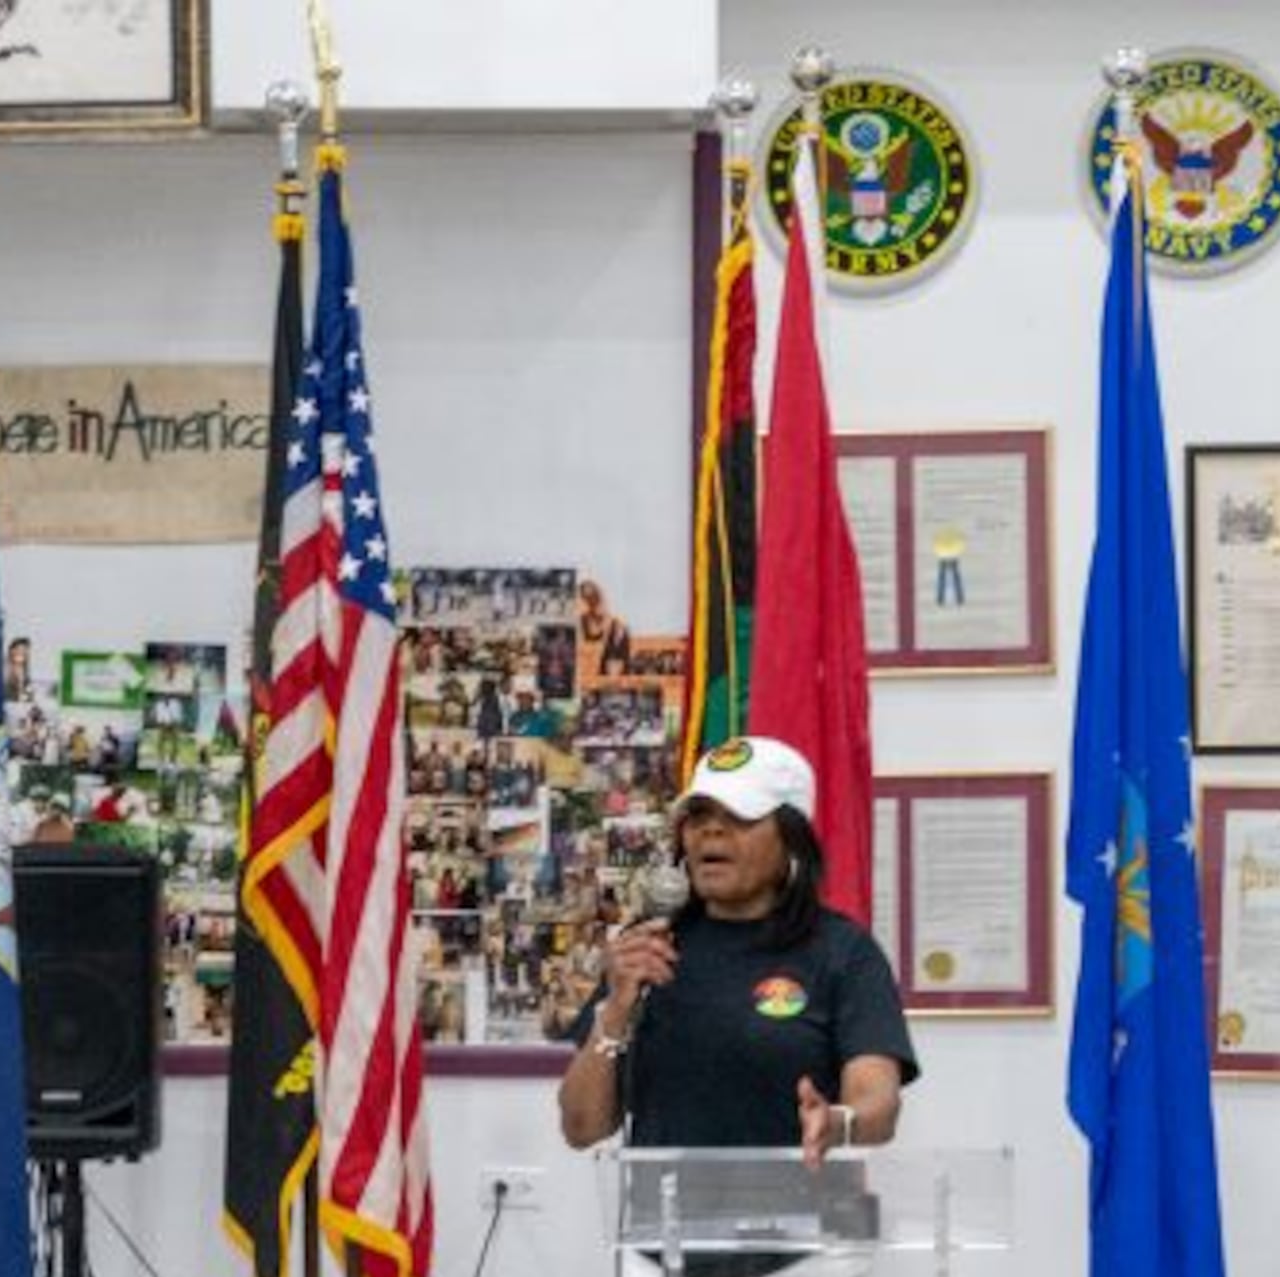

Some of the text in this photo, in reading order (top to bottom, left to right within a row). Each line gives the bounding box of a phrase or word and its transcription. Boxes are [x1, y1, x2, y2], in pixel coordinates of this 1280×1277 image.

[1147, 223, 1231, 257] NAVY
[67, 399, 105, 452] in
[104, 379, 270, 461] America
